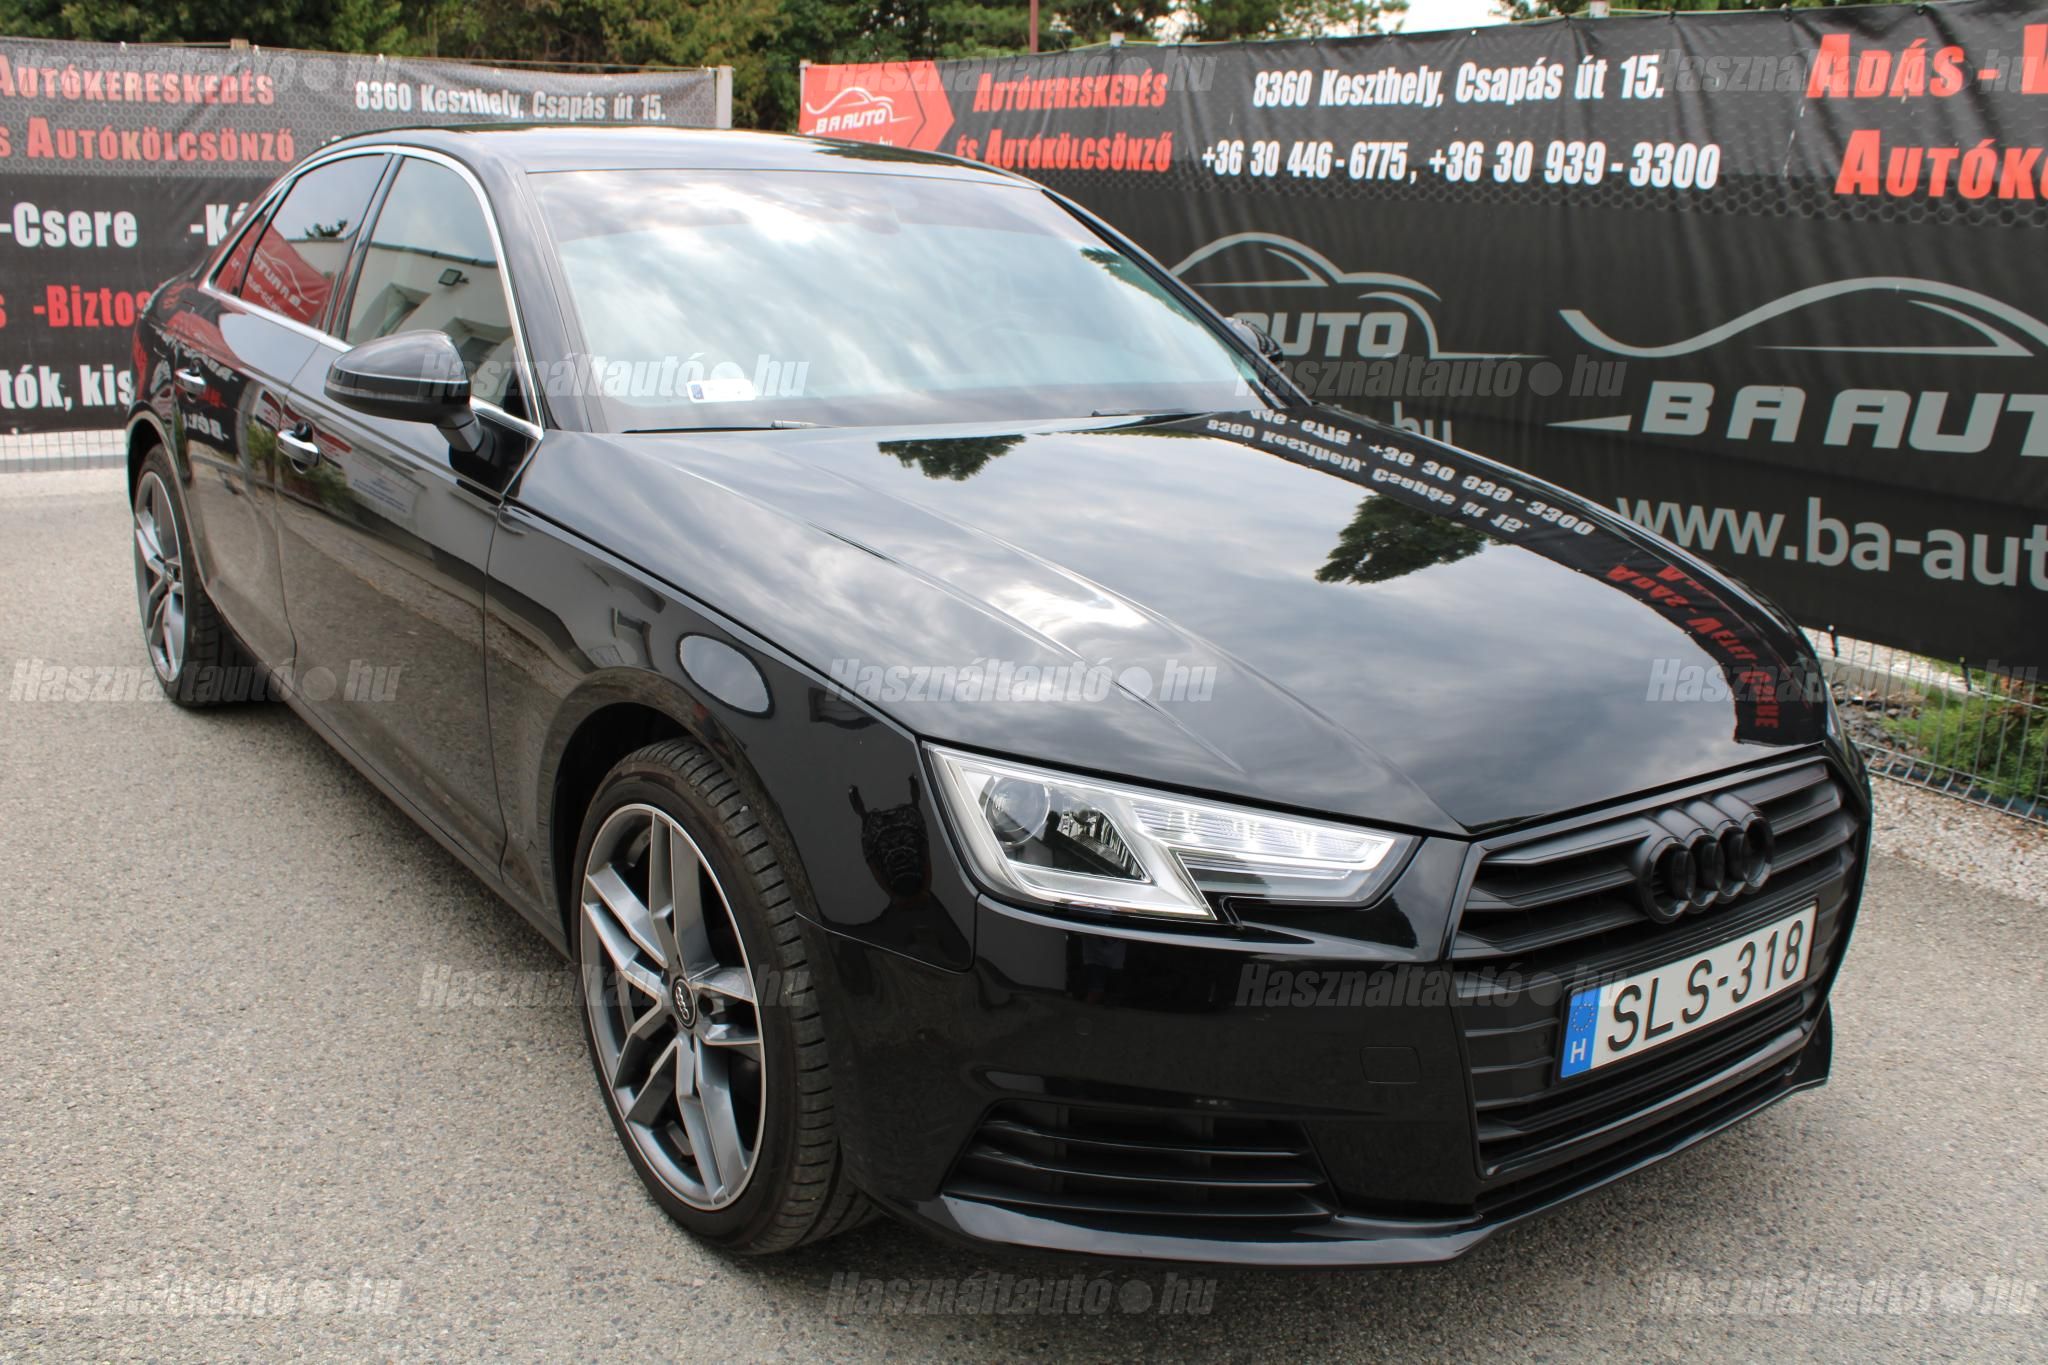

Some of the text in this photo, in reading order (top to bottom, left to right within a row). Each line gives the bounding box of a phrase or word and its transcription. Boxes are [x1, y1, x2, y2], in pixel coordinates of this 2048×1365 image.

[1252, 54, 1664, 108] 8360 Keszthely, Csapás út 15.
[1805, 33, 1965, 98] ADÁS
[355, 81, 667, 121] 8360 Keszthely, Csapás út 15.
[972, 68, 1169, 113] AUTÓKERESKEDÉS
[27, 115, 295, 162] AUTÓKÖLCSÖNZŐ
[984, 129, 1173, 172] AUTÓKÖLCSÖNZŐ
[1202, 139, 1244, 176] +36
[1249, 139, 1281, 177] 30
[1428, 140, 1485, 183] +36
[1493, 140, 1534, 183] 30
[1834, 130, 2048, 199] AUTÓK
[1607, 919, 1805, 1053] SLS-318
[1569, 1037, 1588, 1064] H
